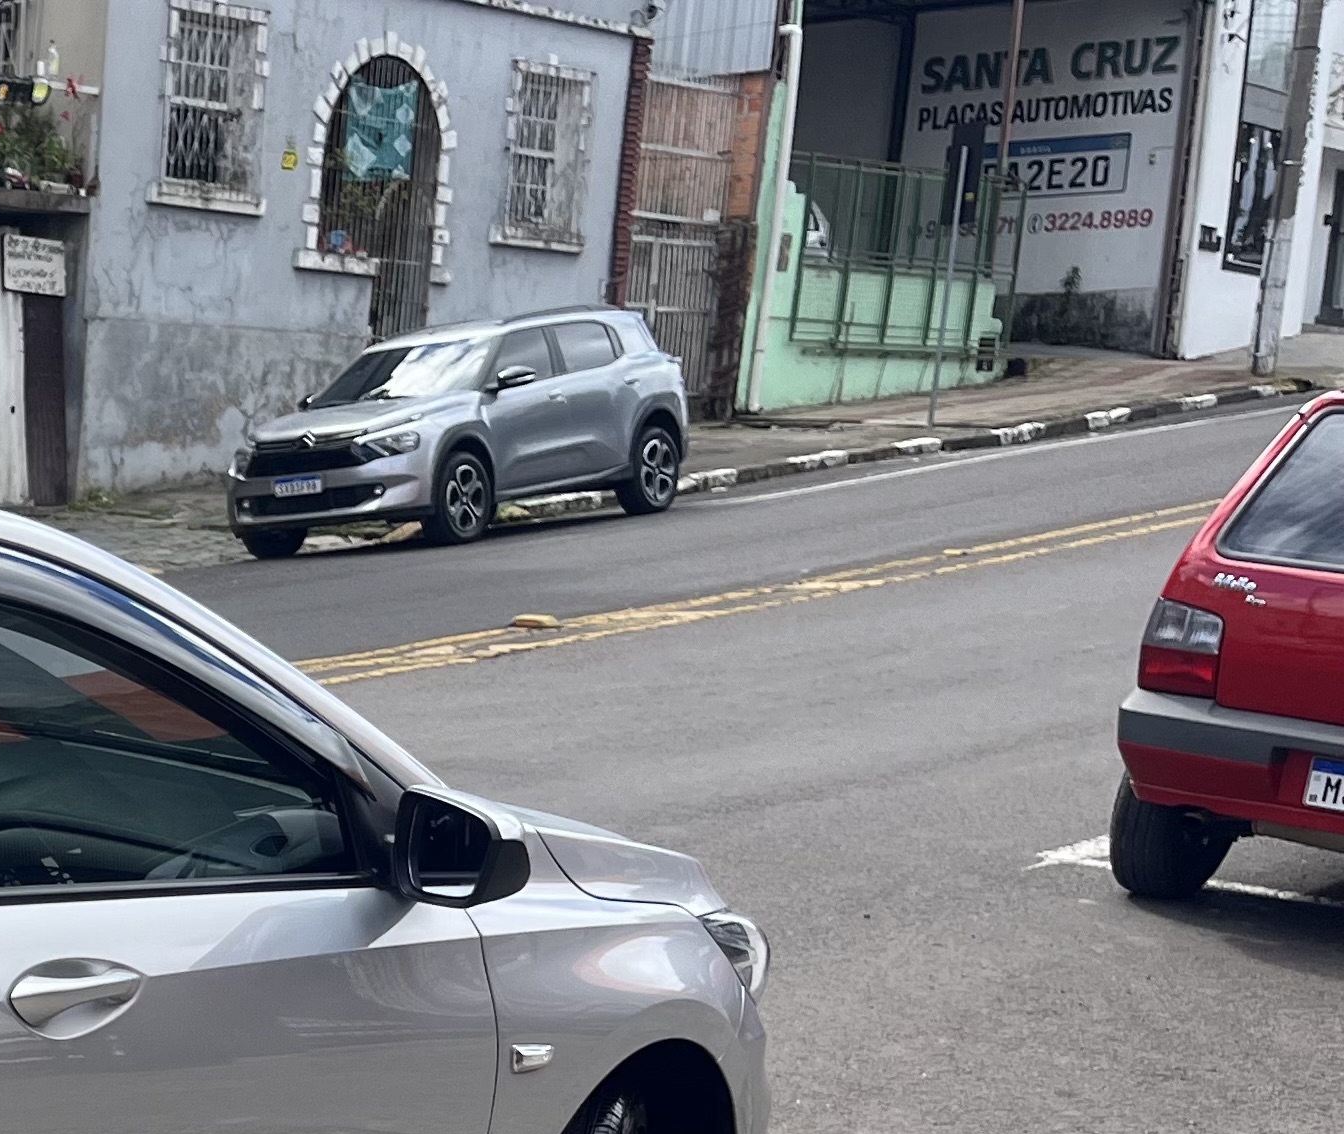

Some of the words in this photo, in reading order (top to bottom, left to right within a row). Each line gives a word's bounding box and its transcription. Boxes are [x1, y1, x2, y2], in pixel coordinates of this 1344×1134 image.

[1070, 35, 1181, 81] CRUZ
[917, 100, 1004, 132] PLACAS
[1010, 86, 1173, 124] AUTOMOTIVAS
[1043, 208, 1154, 233] 3224.8989
